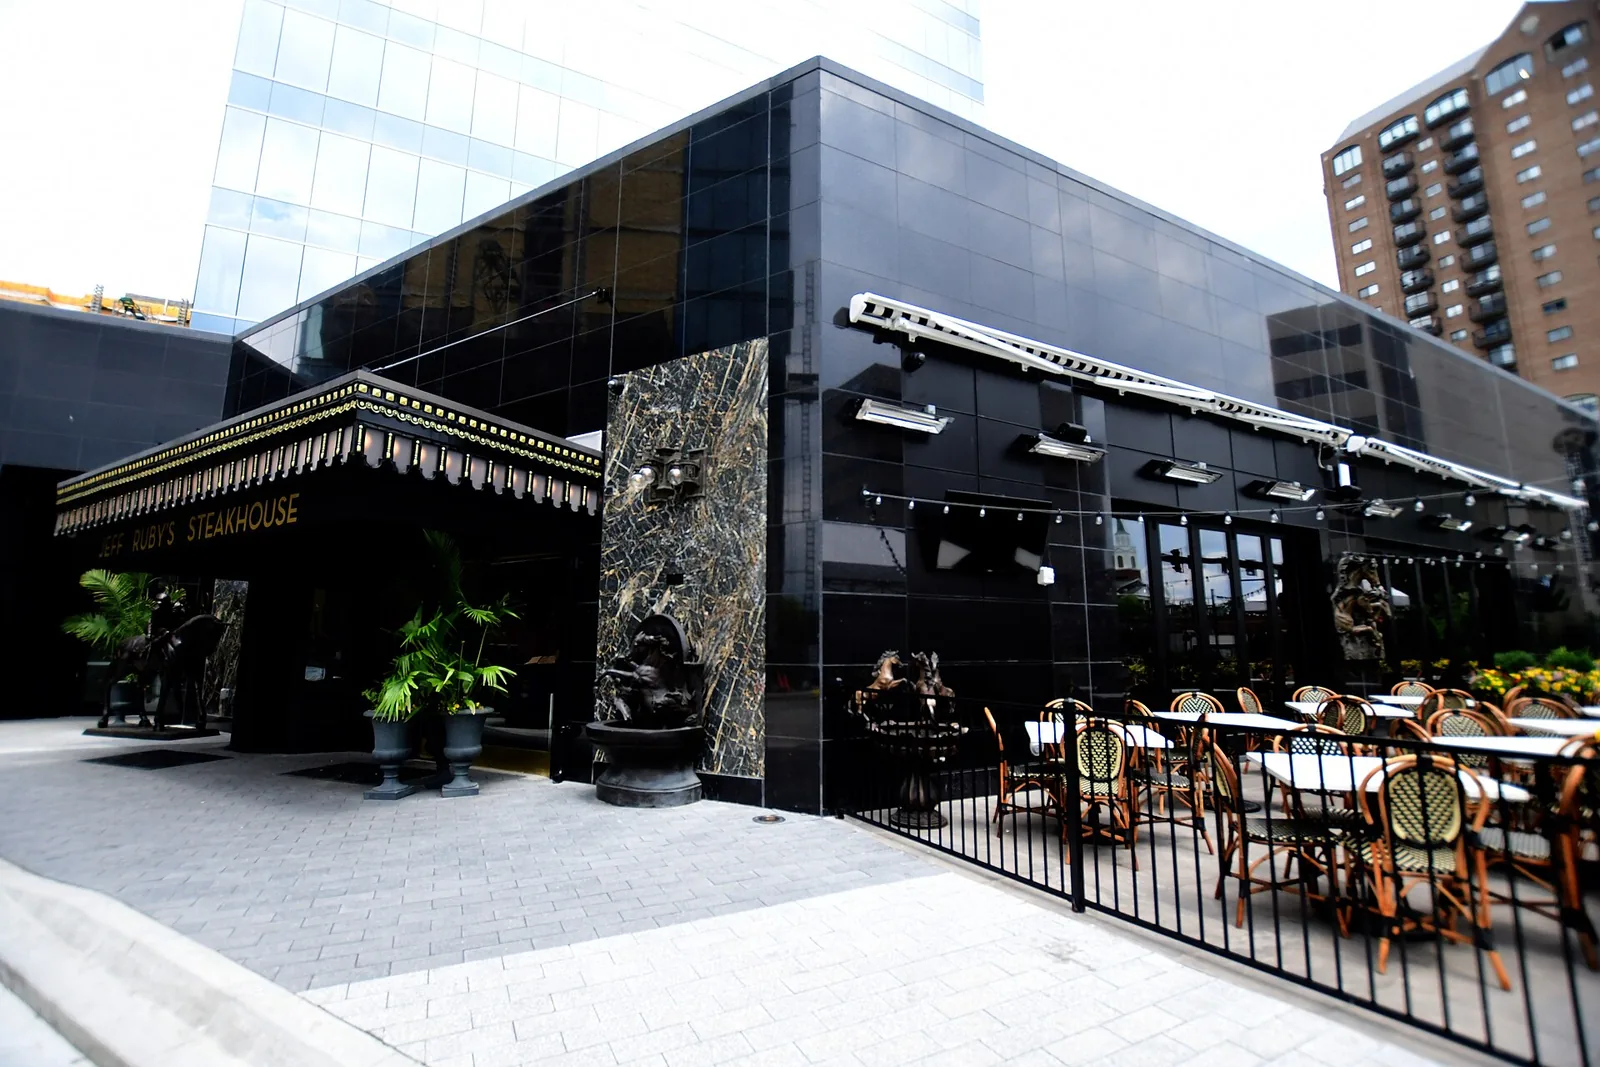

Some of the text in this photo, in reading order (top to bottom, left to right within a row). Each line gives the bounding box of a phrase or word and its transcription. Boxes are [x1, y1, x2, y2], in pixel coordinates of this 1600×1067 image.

[98, 493, 300, 558] JEFF RUBY'S STEAKHOUSE
